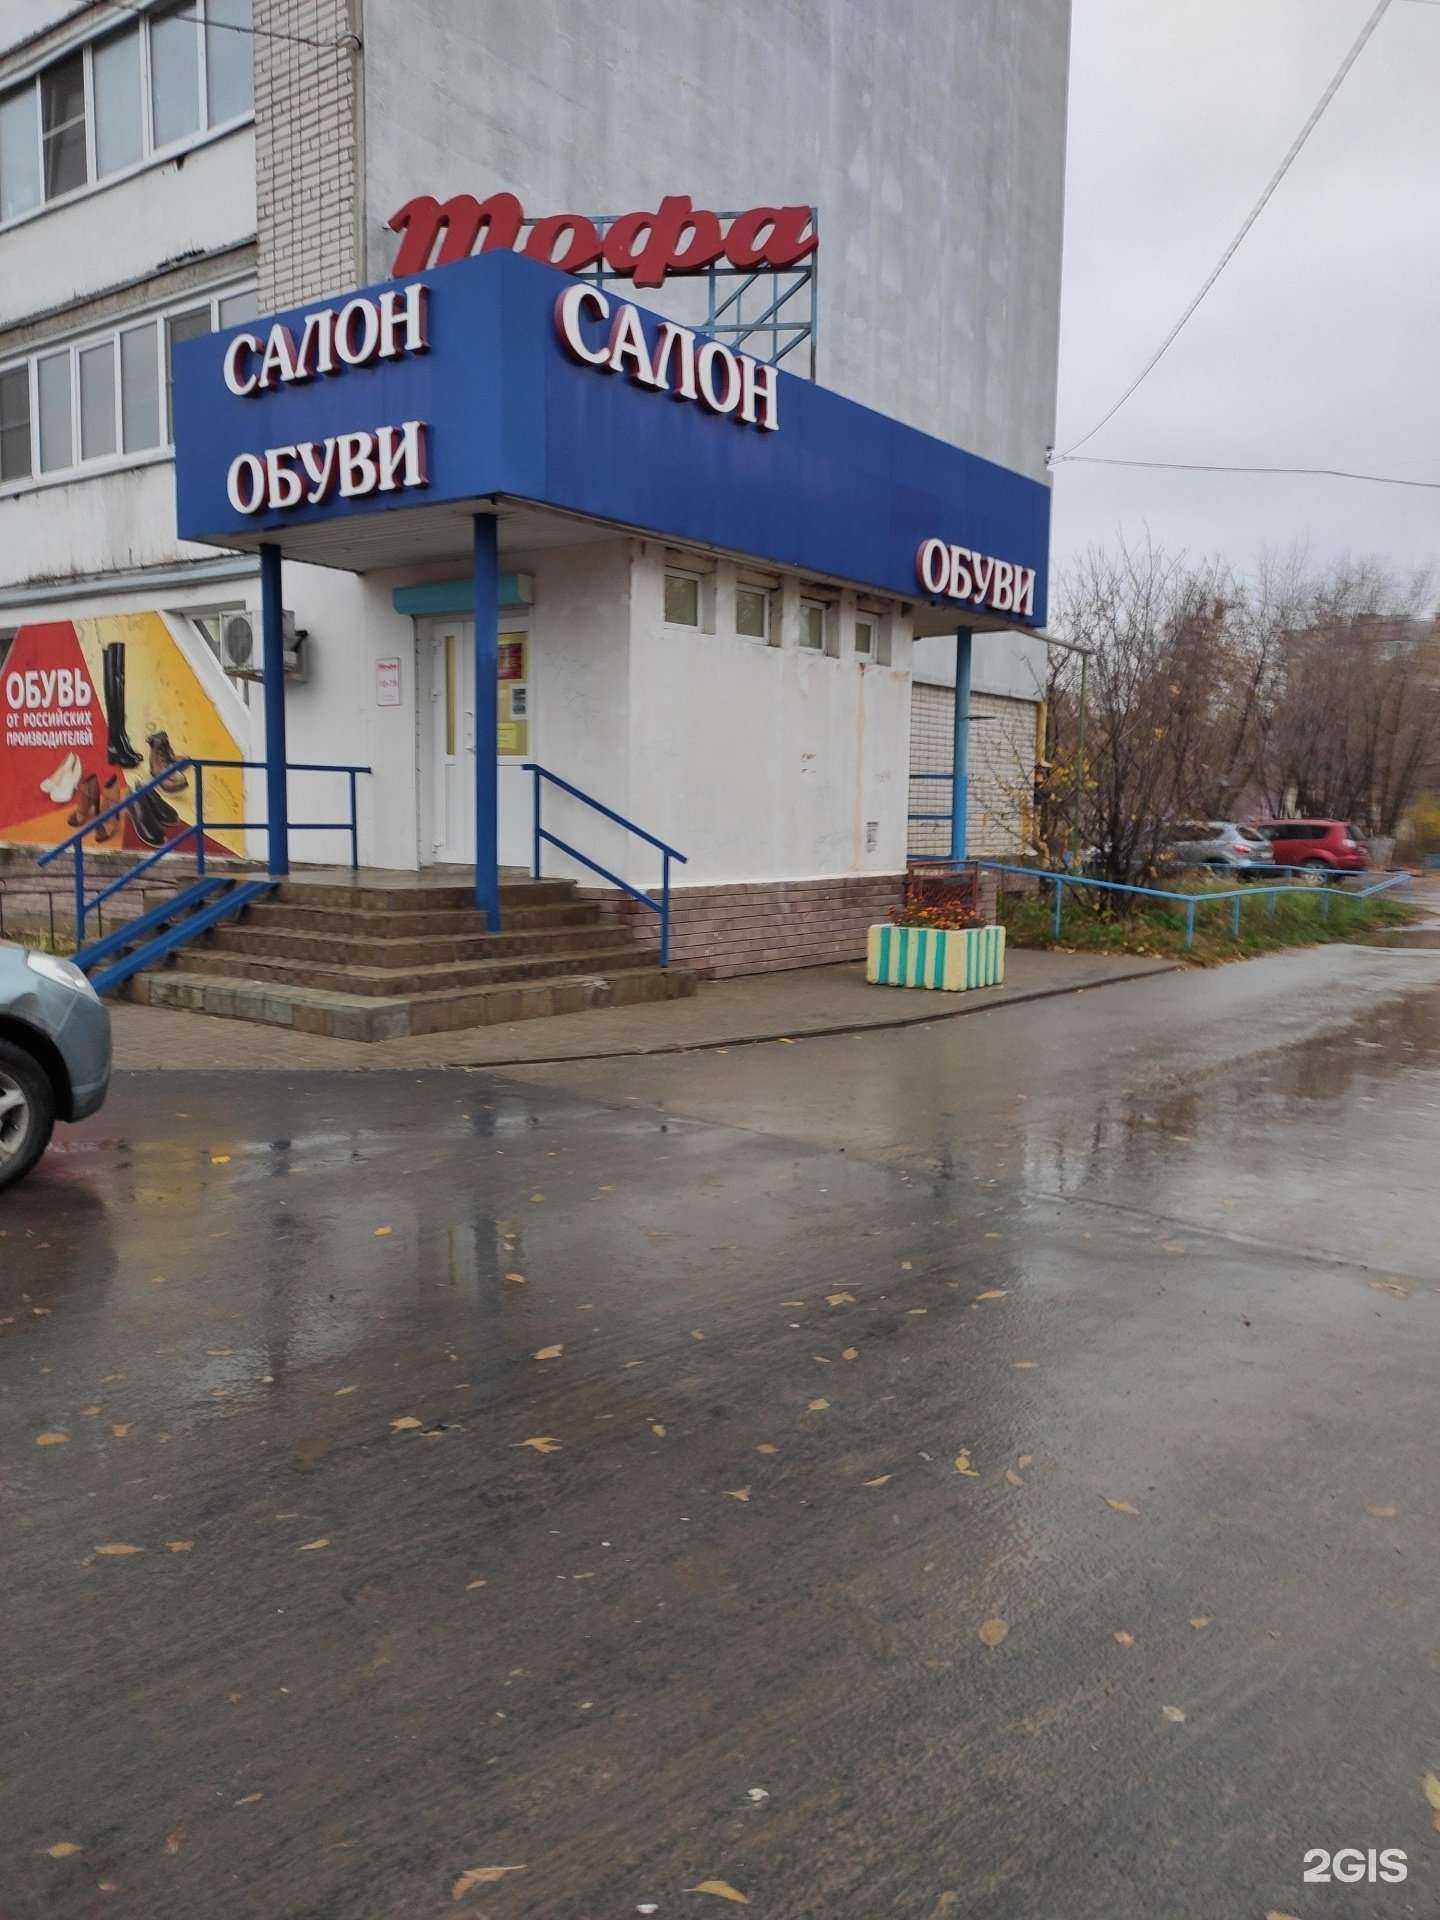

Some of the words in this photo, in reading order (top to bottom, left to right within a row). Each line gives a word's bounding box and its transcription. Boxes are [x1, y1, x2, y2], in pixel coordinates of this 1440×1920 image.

[223, 283, 431, 397] САЛОН
[555, 283, 780, 431] САЛОН
[227, 420, 428, 515] ОБУВИ
[916, 537, 1037, 617] ОБУВИ
[5, 667, 92, 710] ОБУВЬ
